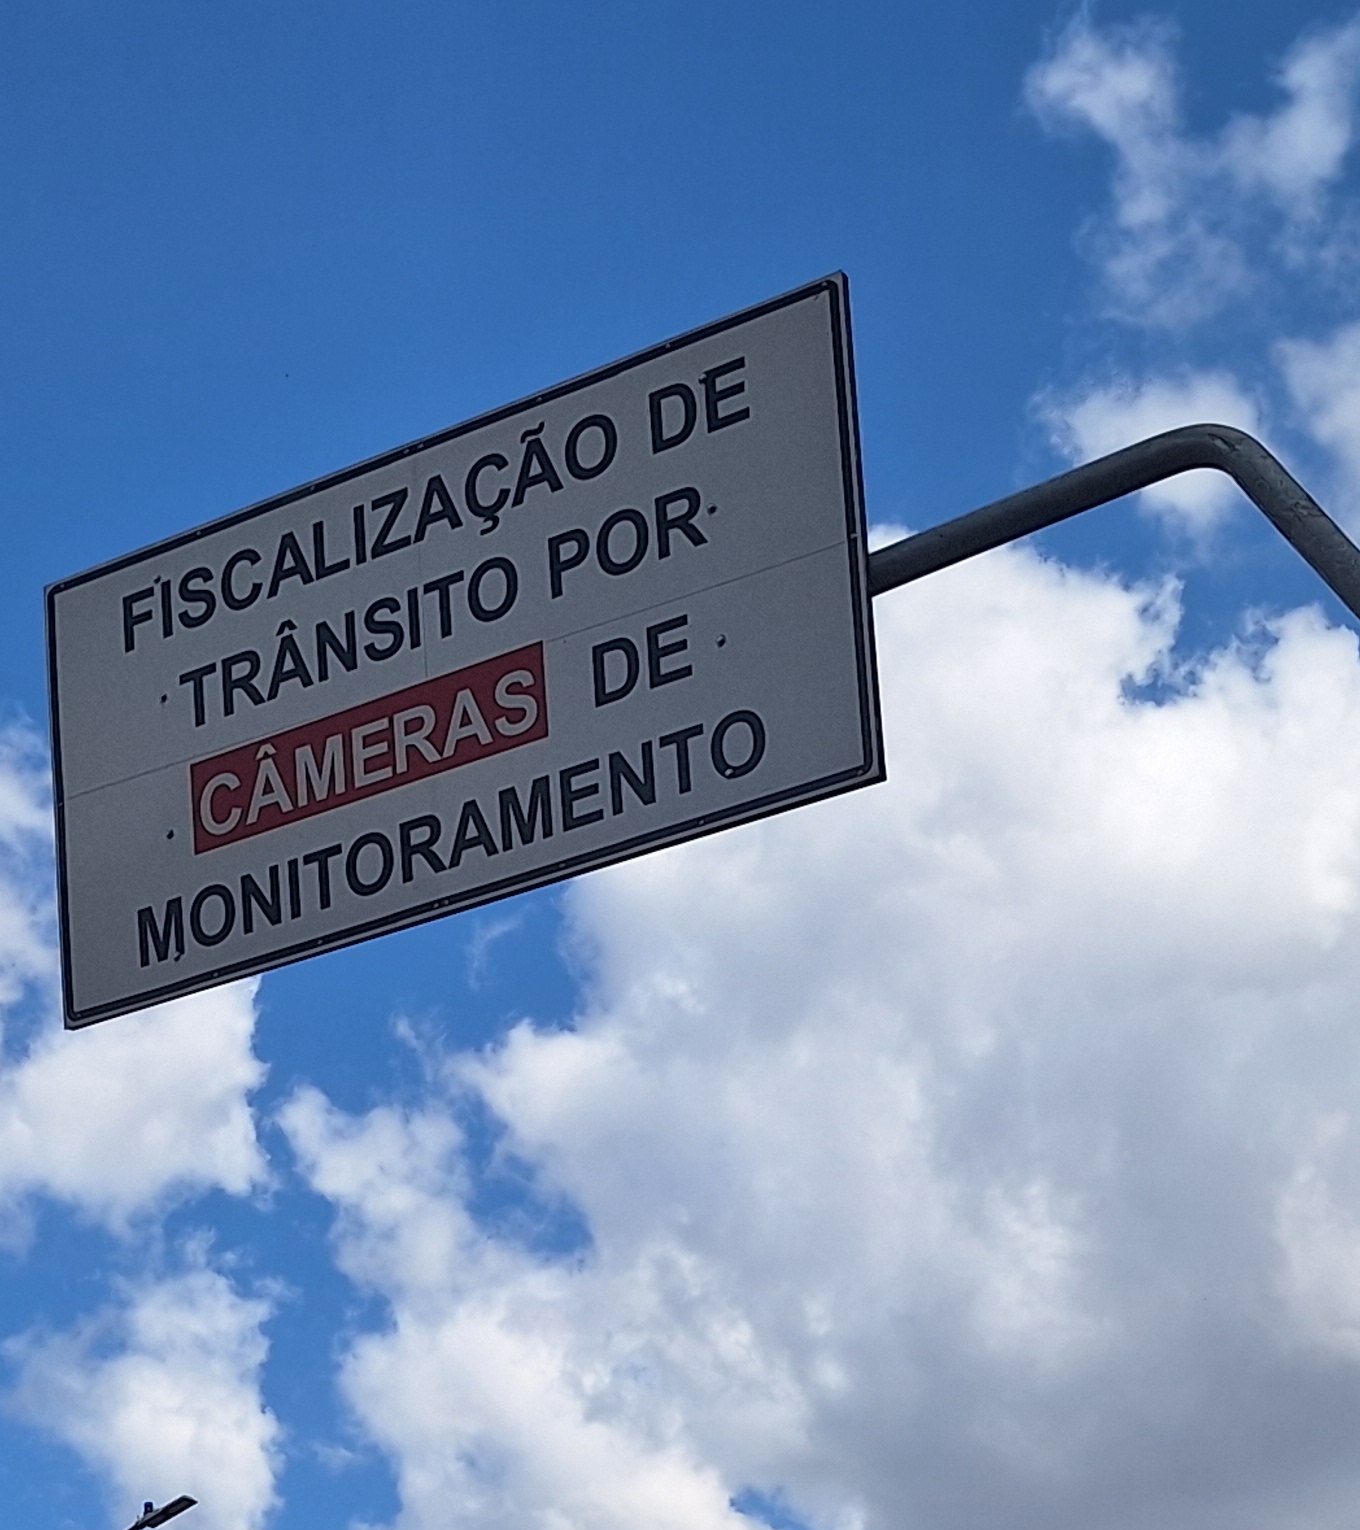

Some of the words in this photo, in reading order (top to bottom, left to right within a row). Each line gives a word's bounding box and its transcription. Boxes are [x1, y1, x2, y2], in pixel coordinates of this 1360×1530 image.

[122, 414, 618, 654] FISCALIZAÇÃO
[647, 355, 752, 455] DE
[178, 556, 519, 728] TRÂNSITO
[547, 486, 709, 600] POR
[136, 709, 767, 969] MONITORAMENTO
[198, 668, 540, 837] CÂMERAS
[591, 613, 694, 708] DE
